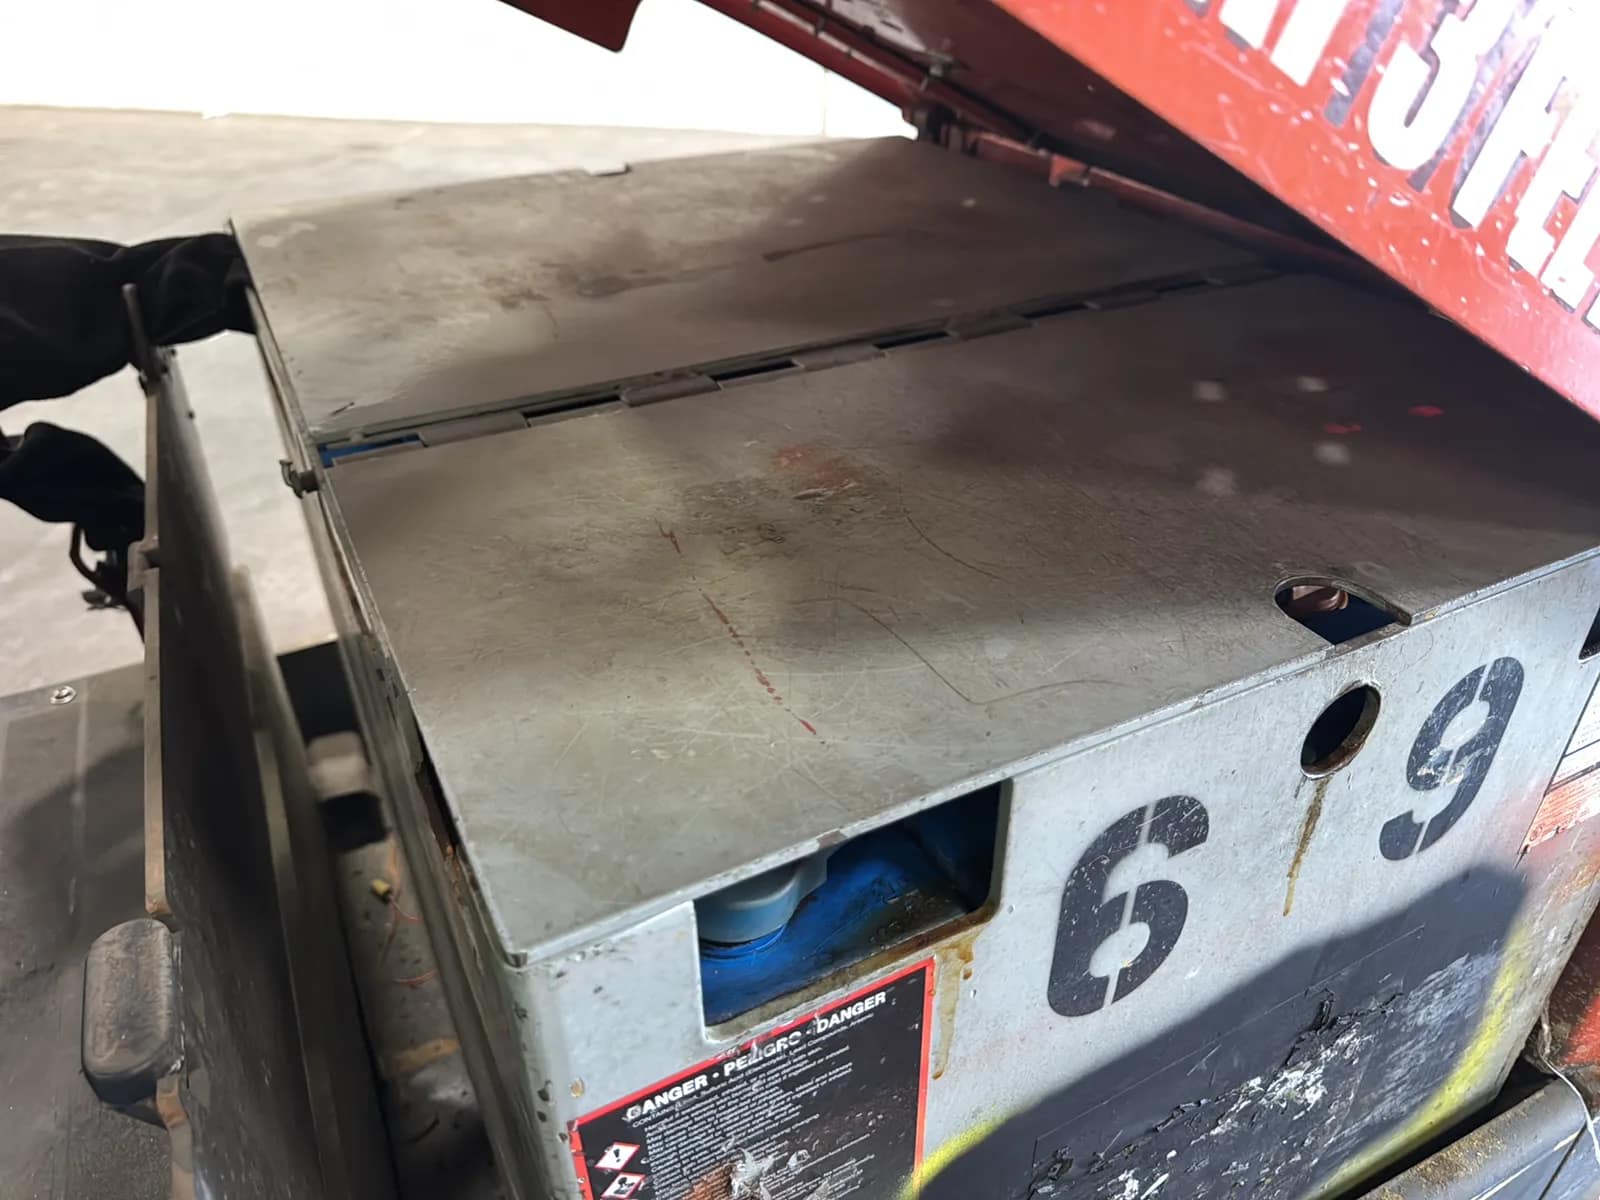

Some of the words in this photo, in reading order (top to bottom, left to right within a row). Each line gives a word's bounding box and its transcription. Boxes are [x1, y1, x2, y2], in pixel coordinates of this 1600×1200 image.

[1048, 795, 1209, 1017] 6
[1379, 656, 1524, 861] 9
[816, 992, 886, 1033] DANGER
